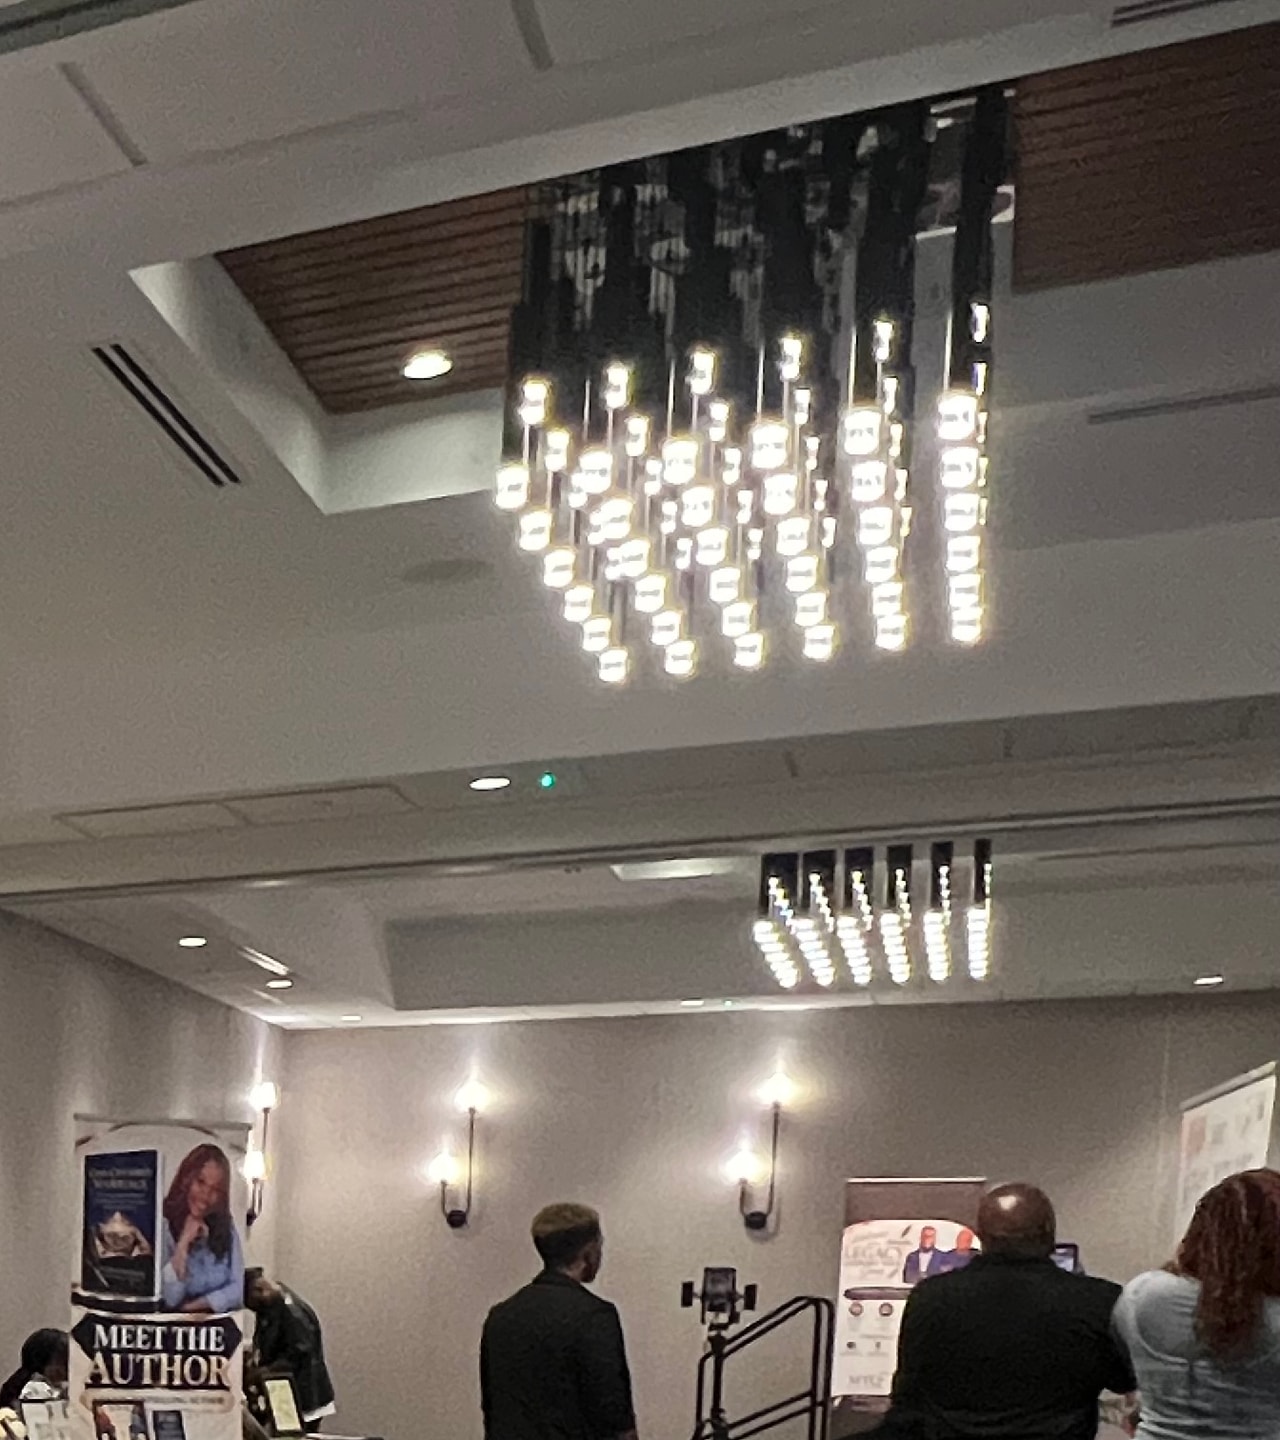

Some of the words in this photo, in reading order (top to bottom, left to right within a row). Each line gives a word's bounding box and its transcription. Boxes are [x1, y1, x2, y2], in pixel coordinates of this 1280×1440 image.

[92, 1323, 170, 1350] MEET
[171, 1326, 225, 1352] THE
[86, 1351, 231, 1387] AUTHOR
